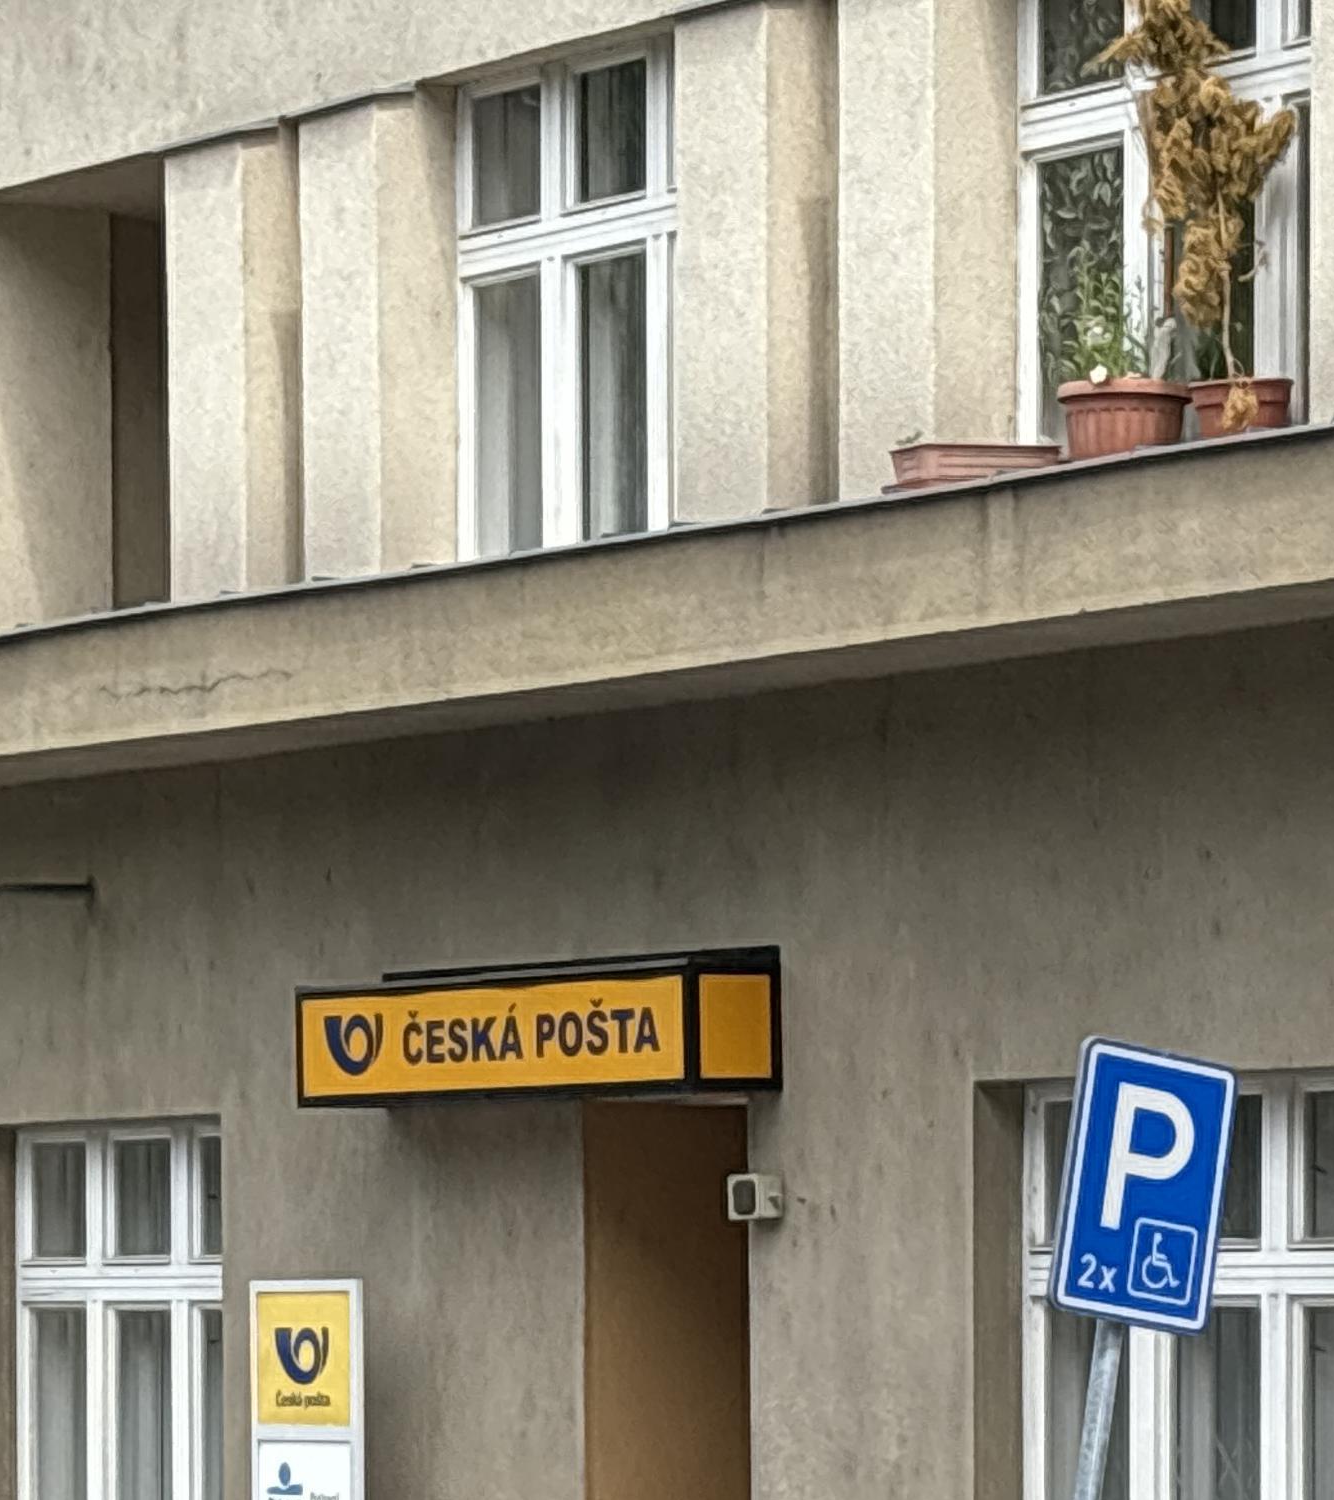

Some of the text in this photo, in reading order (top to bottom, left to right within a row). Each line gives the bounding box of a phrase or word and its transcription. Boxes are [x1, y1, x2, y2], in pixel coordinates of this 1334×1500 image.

[402, 999, 661, 1066] ČESKÁ POŠTA
[1100, 1081, 1194, 1230] P
[1077, 1253, 1117, 1293] 2x
